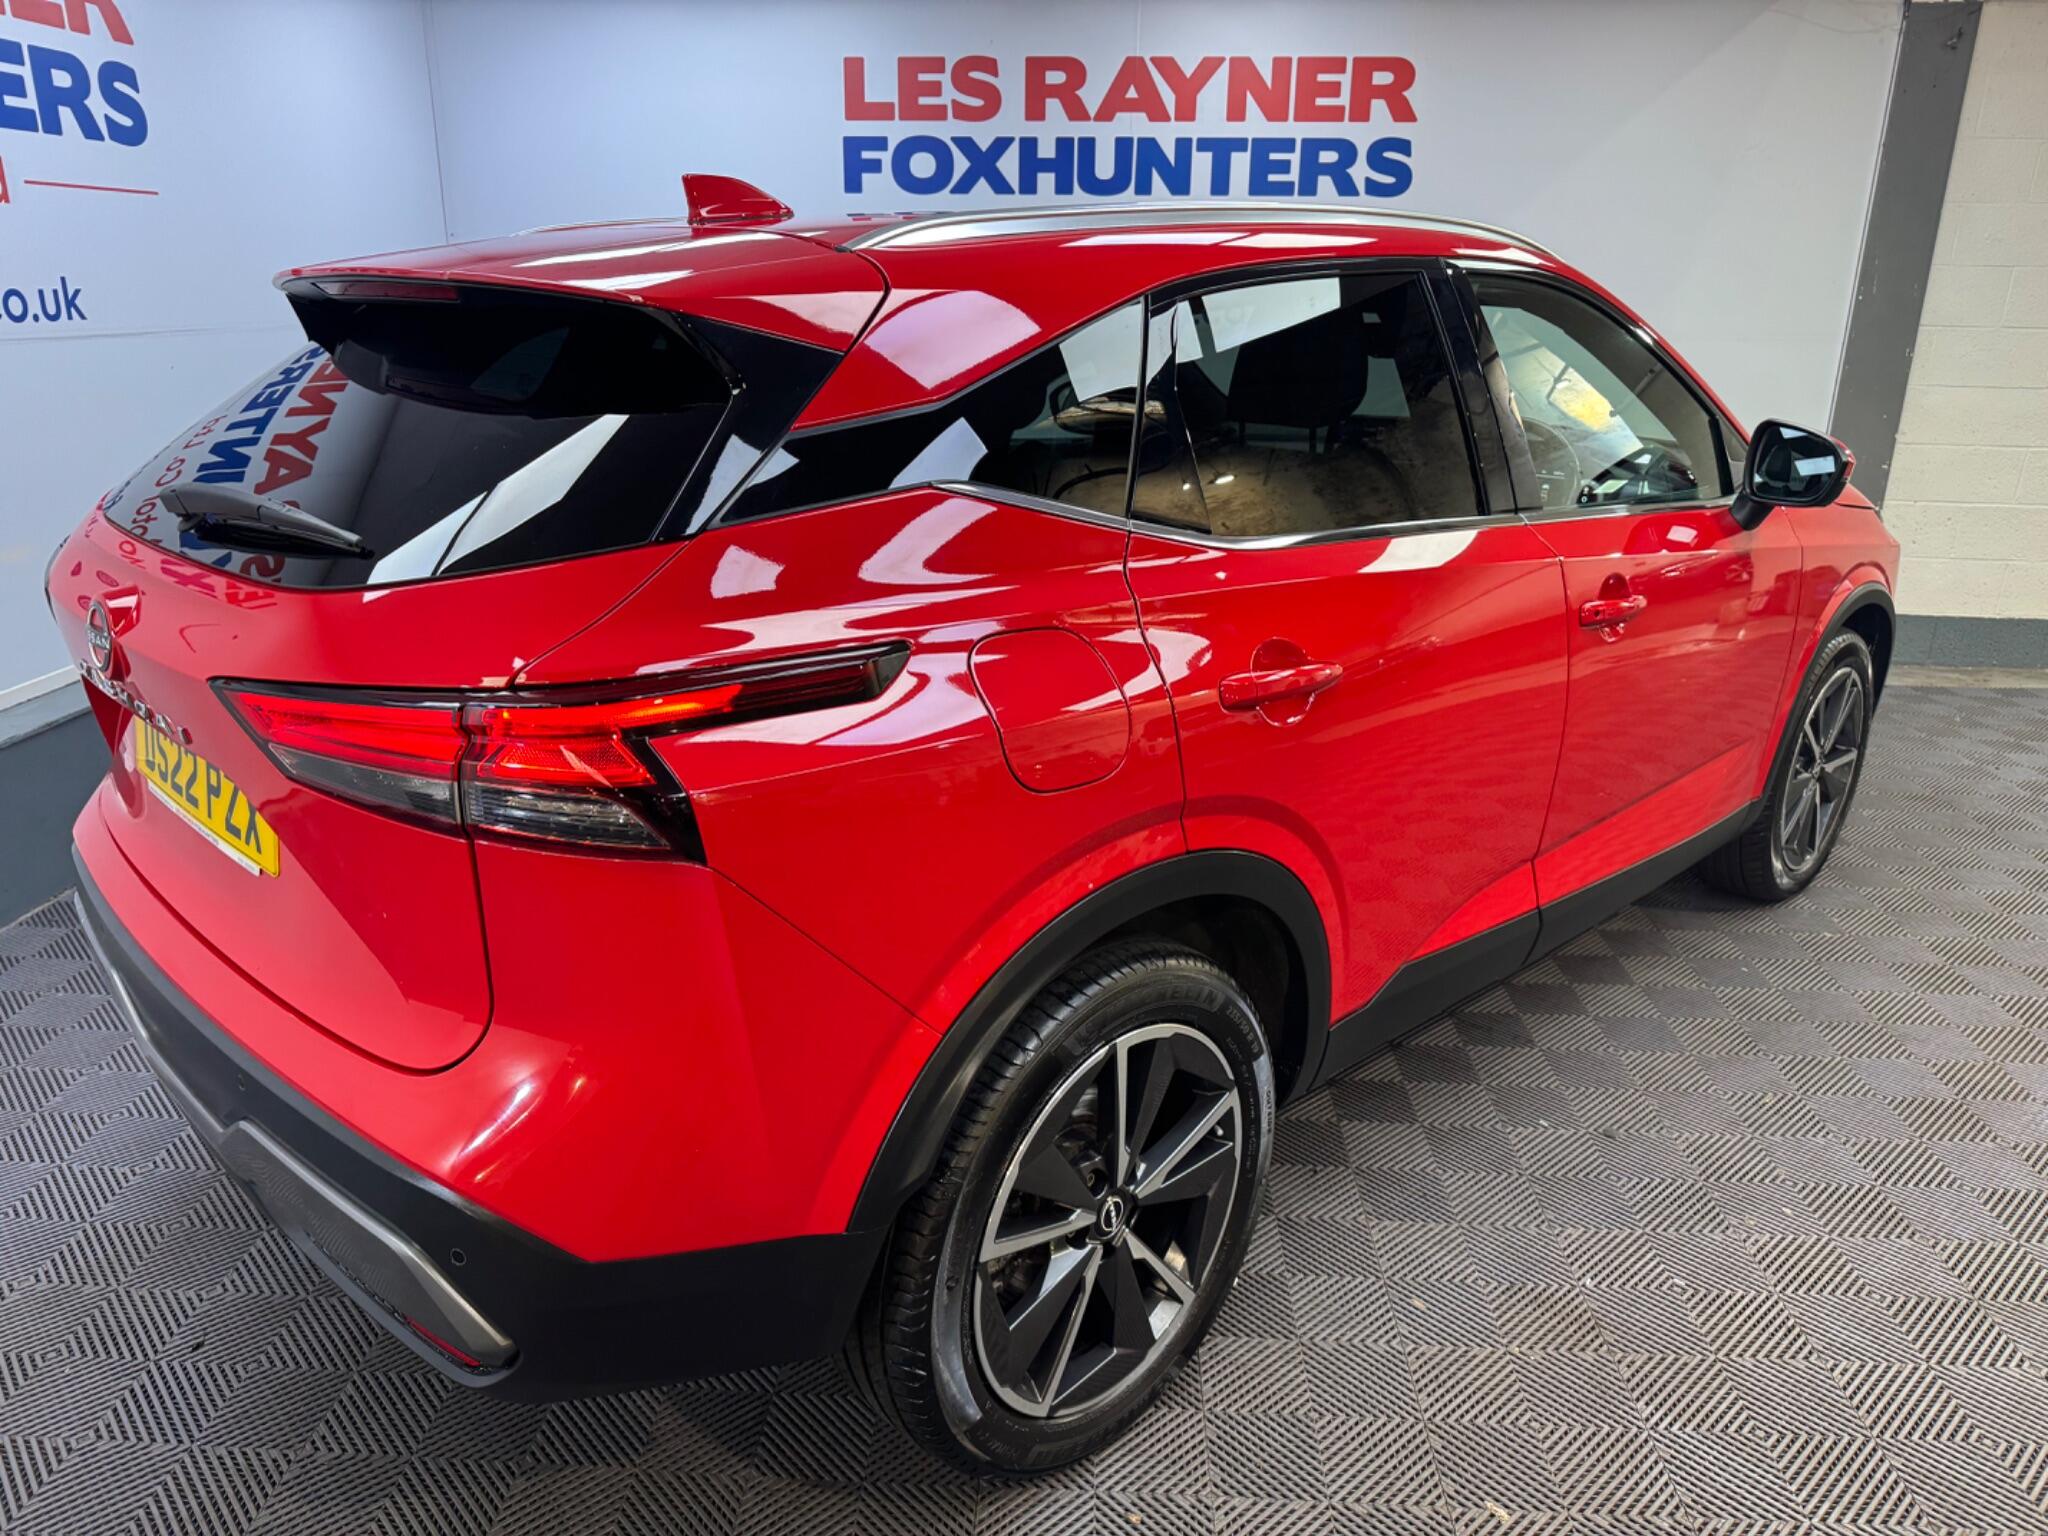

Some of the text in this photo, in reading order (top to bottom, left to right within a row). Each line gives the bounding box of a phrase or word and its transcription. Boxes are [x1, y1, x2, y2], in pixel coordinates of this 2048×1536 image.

[843, 55, 1418, 123] LES RAYNER
[843, 135, 1413, 198] FOXHUNTERS
[0, 276, 87, 323] o.uk
